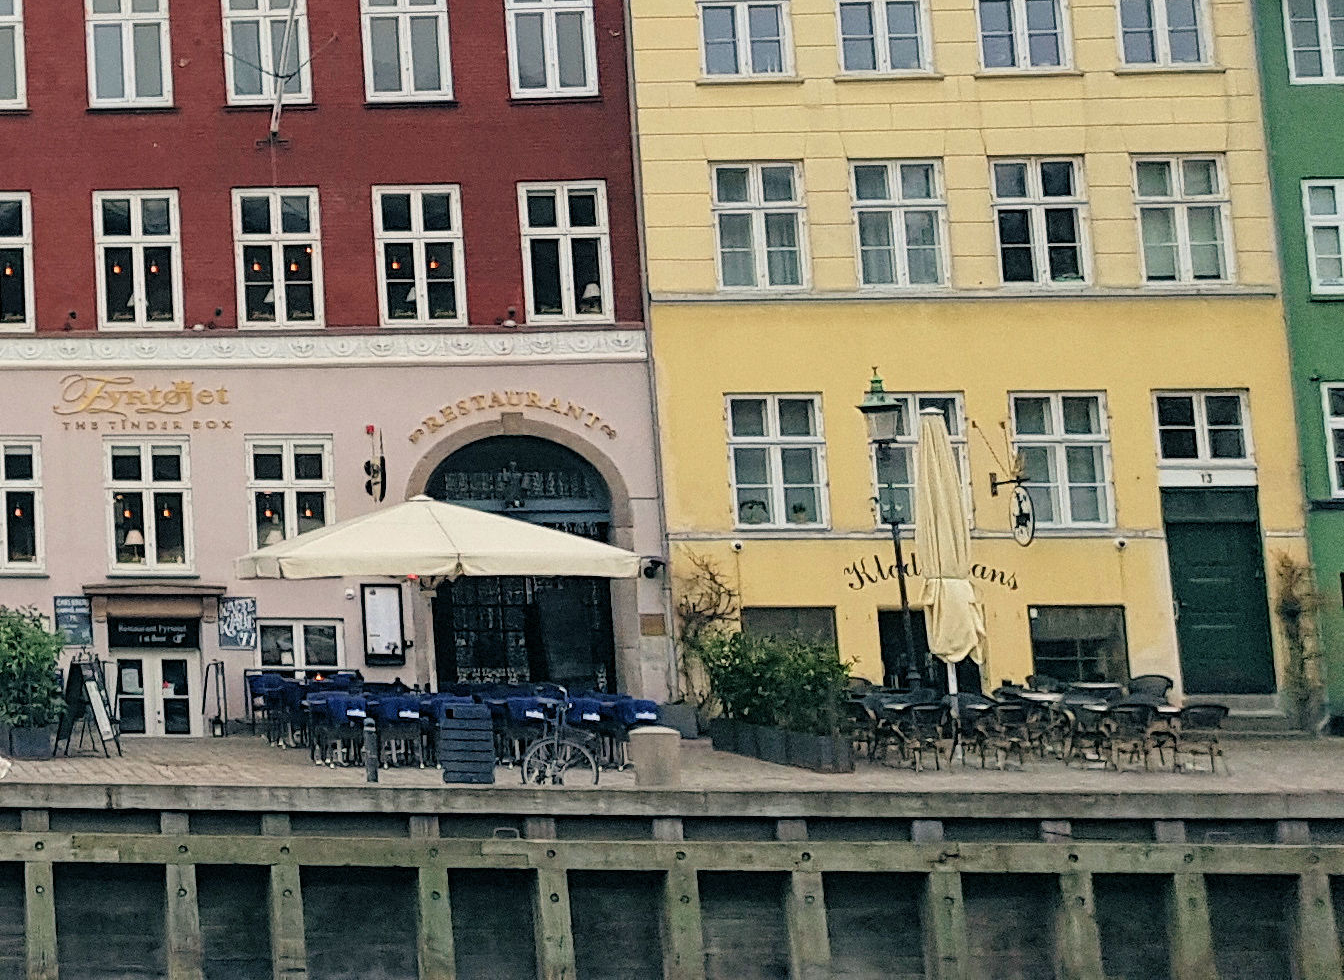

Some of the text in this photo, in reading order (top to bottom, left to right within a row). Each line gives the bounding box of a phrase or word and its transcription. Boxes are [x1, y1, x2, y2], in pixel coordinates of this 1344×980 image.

[421, 389, 600, 434] RESTAURANT
[62, 419, 233, 431] THE TINDER BOX
[1201, 473, 1213, 484] 13
